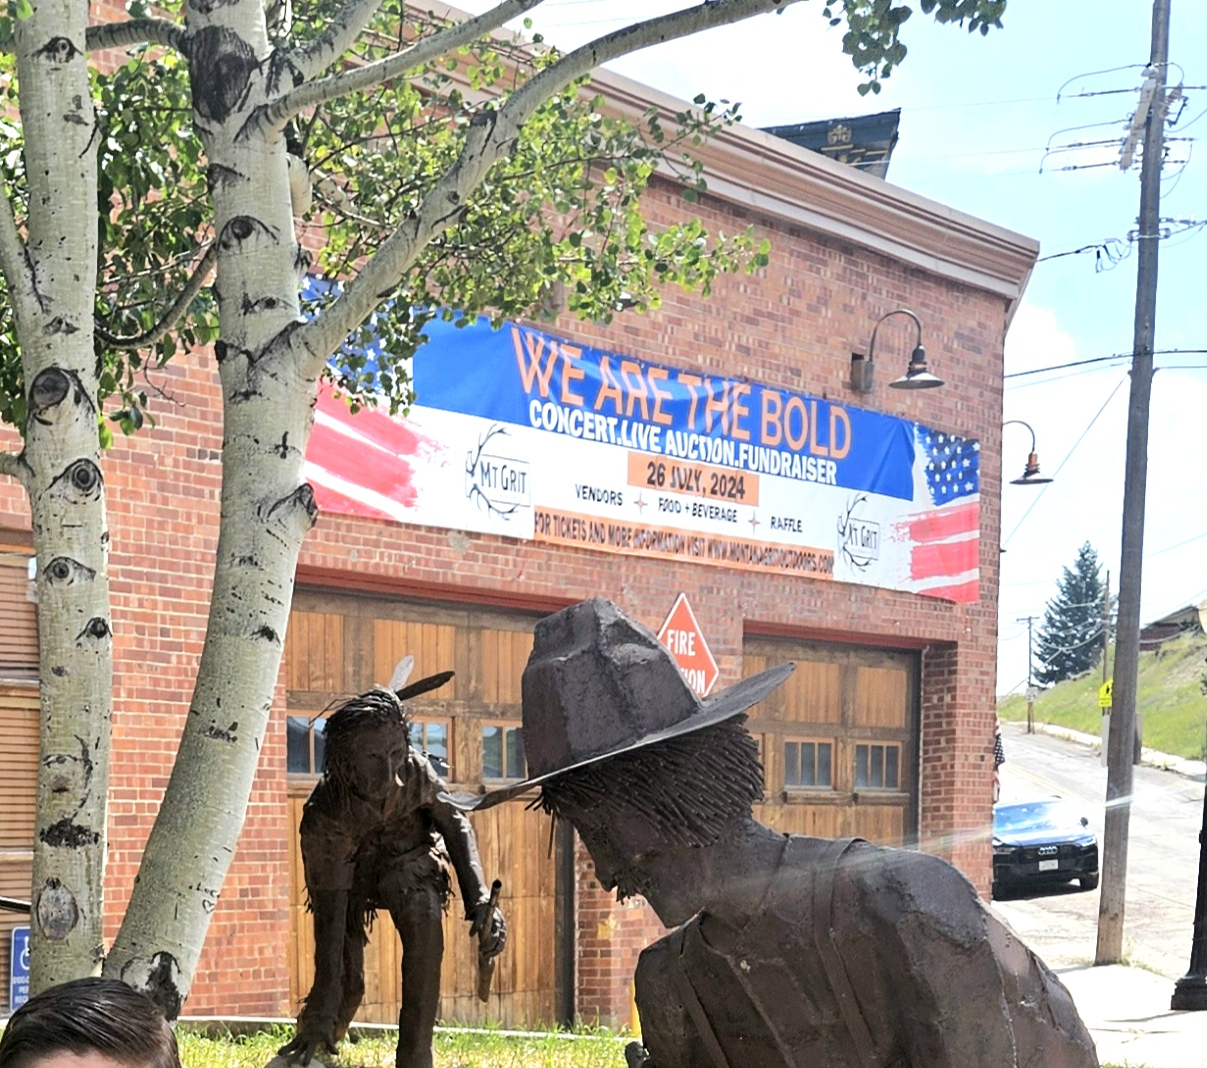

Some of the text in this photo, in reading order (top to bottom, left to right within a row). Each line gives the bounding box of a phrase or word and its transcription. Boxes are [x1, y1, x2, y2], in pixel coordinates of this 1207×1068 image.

[511, 327, 852, 460] WE ARE THE BOLD
[647, 461, 746, 500] 26 JULY, 2024
[575, 484, 623, 506] VENDORS
[658, 497, 681, 514] FOOD
[692, 503, 737, 523] BEVERAGE
[770, 516, 803, 533] RAFFLE
[534, 511, 551, 536] FOR
[553, 515, 586, 541] TICKETS
[588, 521, 605, 544] AND
[608, 523, 631, 548] MORE
[667, 629, 695, 656] FIRE
